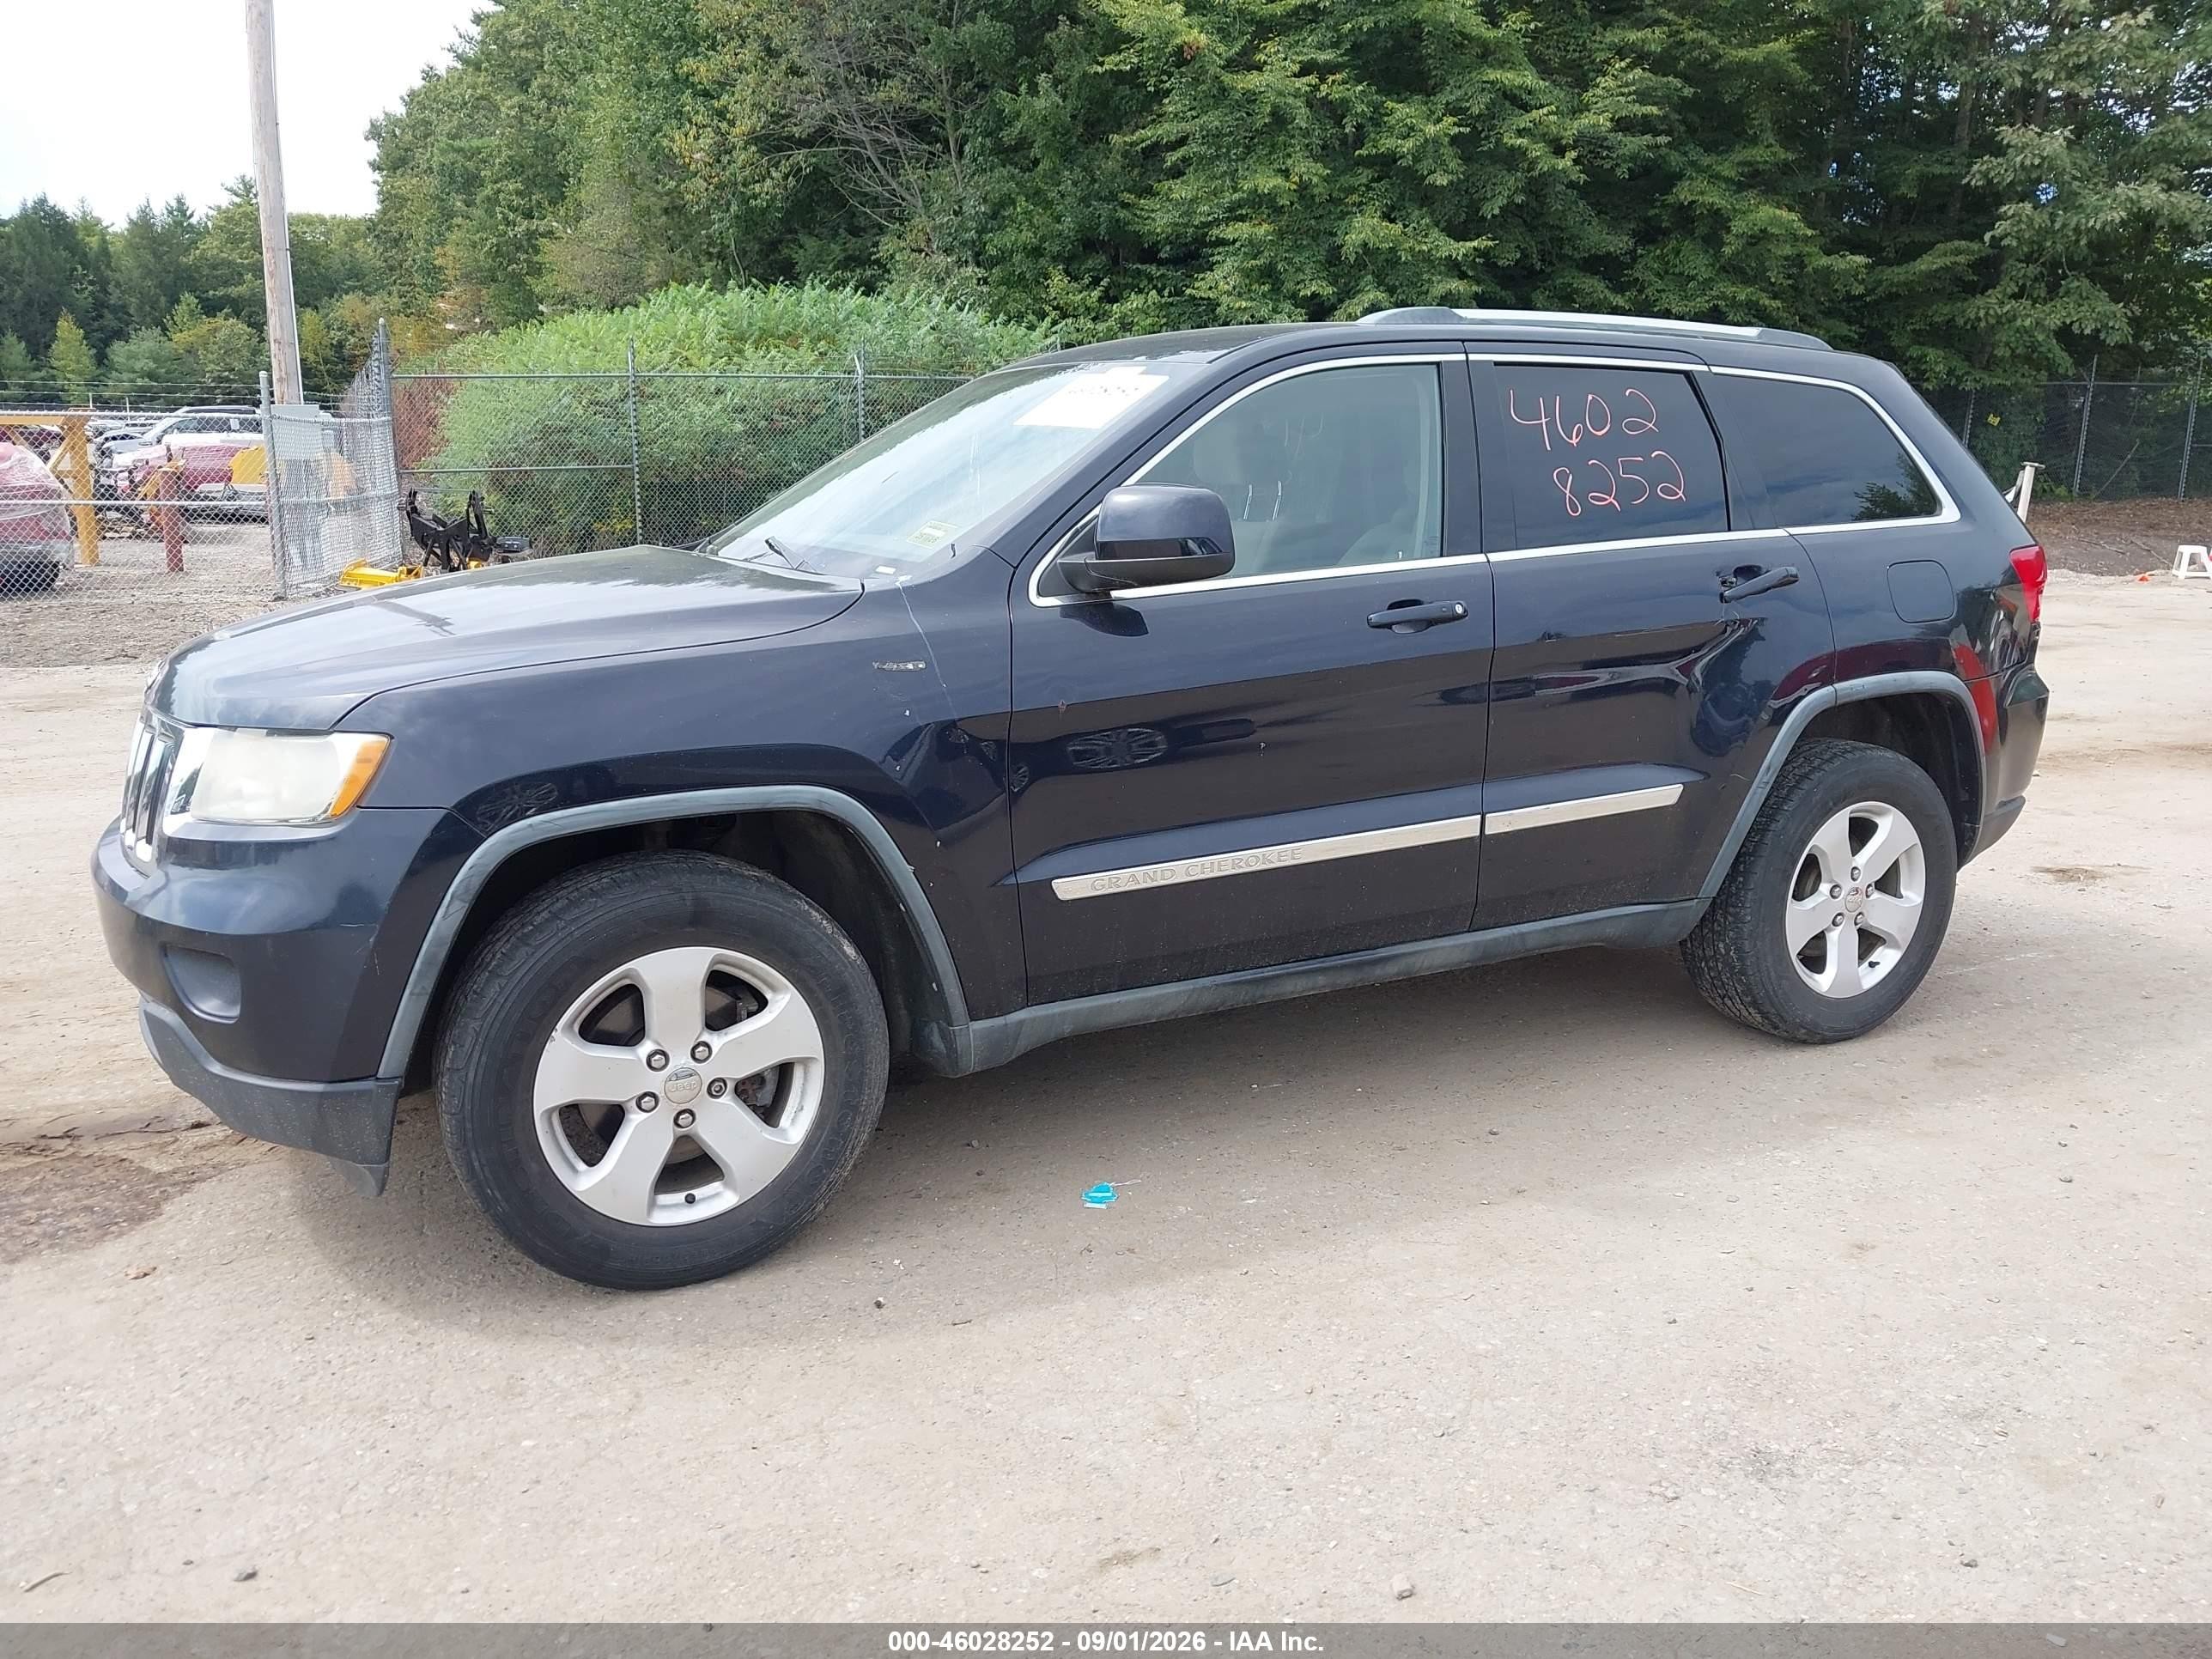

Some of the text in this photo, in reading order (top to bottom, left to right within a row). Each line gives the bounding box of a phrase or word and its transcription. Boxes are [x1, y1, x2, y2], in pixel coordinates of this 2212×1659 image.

[1510, 388, 1659, 451] 4602
[1553, 450, 1686, 516] 8252
[1091, 848, 1303, 891] GRAND CHEROKEE
